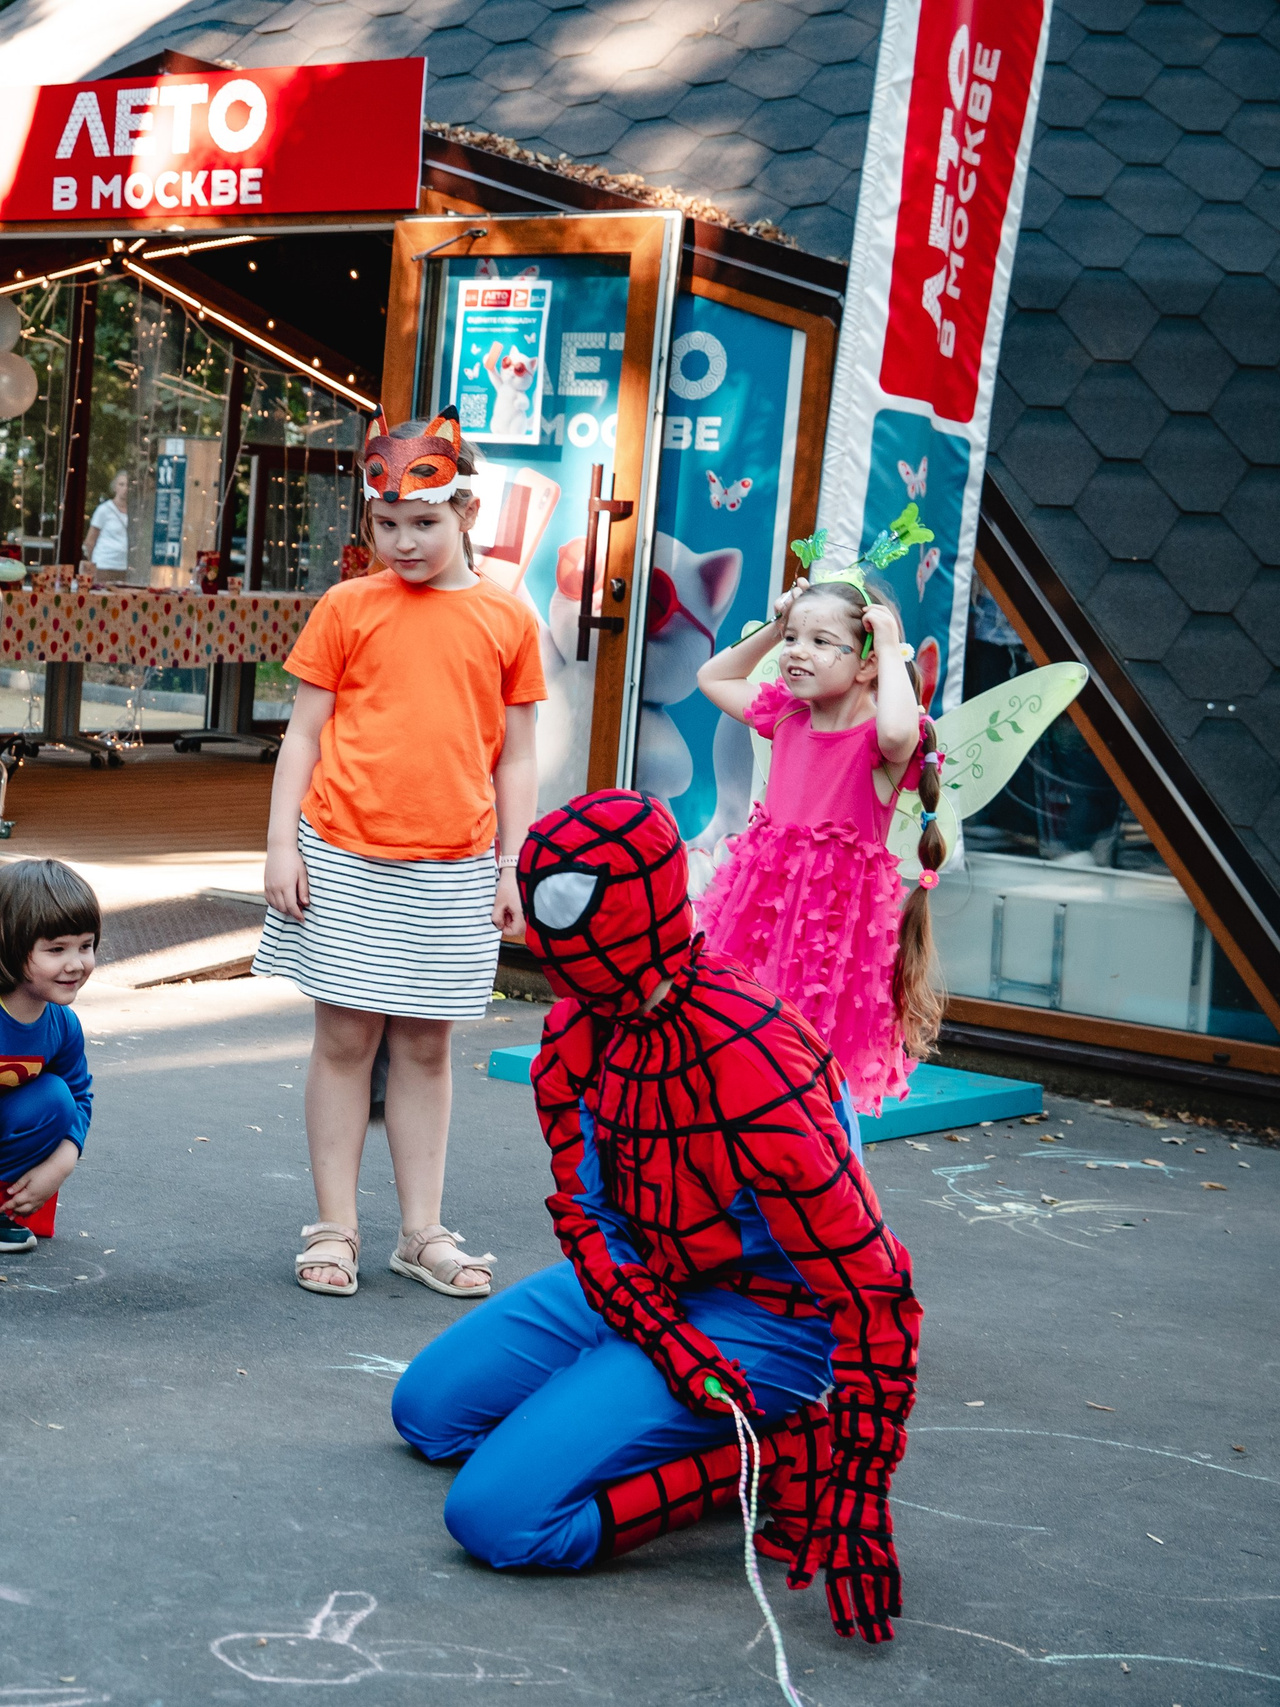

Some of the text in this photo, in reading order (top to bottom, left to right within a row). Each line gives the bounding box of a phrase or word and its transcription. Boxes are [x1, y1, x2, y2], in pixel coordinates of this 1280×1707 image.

[53, 168, 263, 210] В МОСКВЕ
[55, 79, 267, 159] ЛЕТО
[922, 24, 969, 344] ЛЕТО
[939, 42, 1001, 358] В МОСКВЕ
